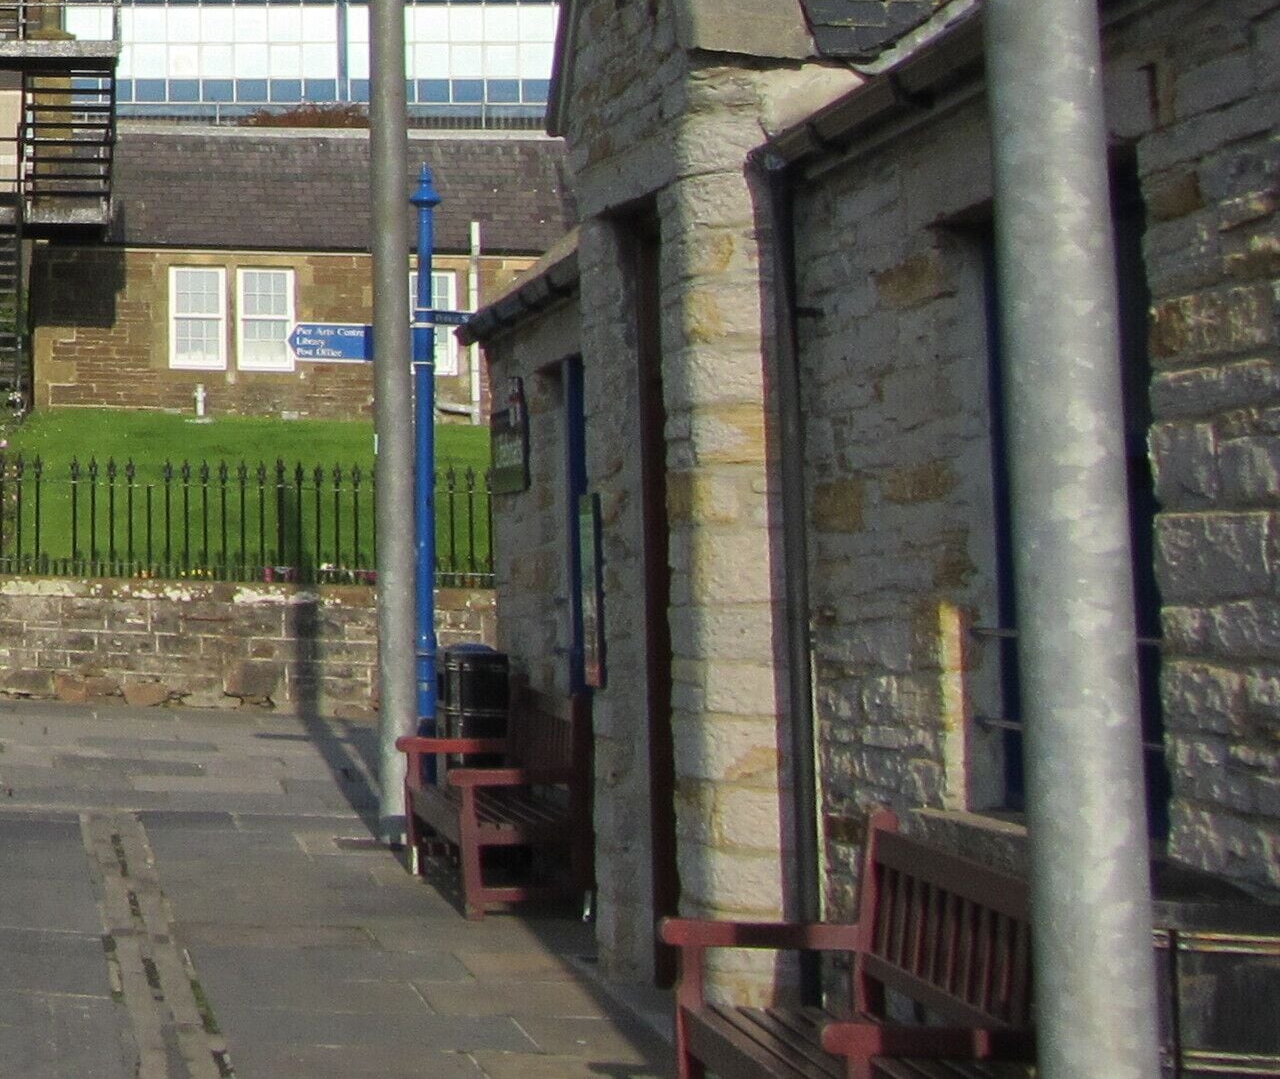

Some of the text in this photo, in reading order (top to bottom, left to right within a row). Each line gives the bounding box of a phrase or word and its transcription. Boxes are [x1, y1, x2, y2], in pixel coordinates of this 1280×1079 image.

[297, 327, 313, 335] Pier
[317, 328, 335, 336] Arts
[316, 348, 343, 357] Office
